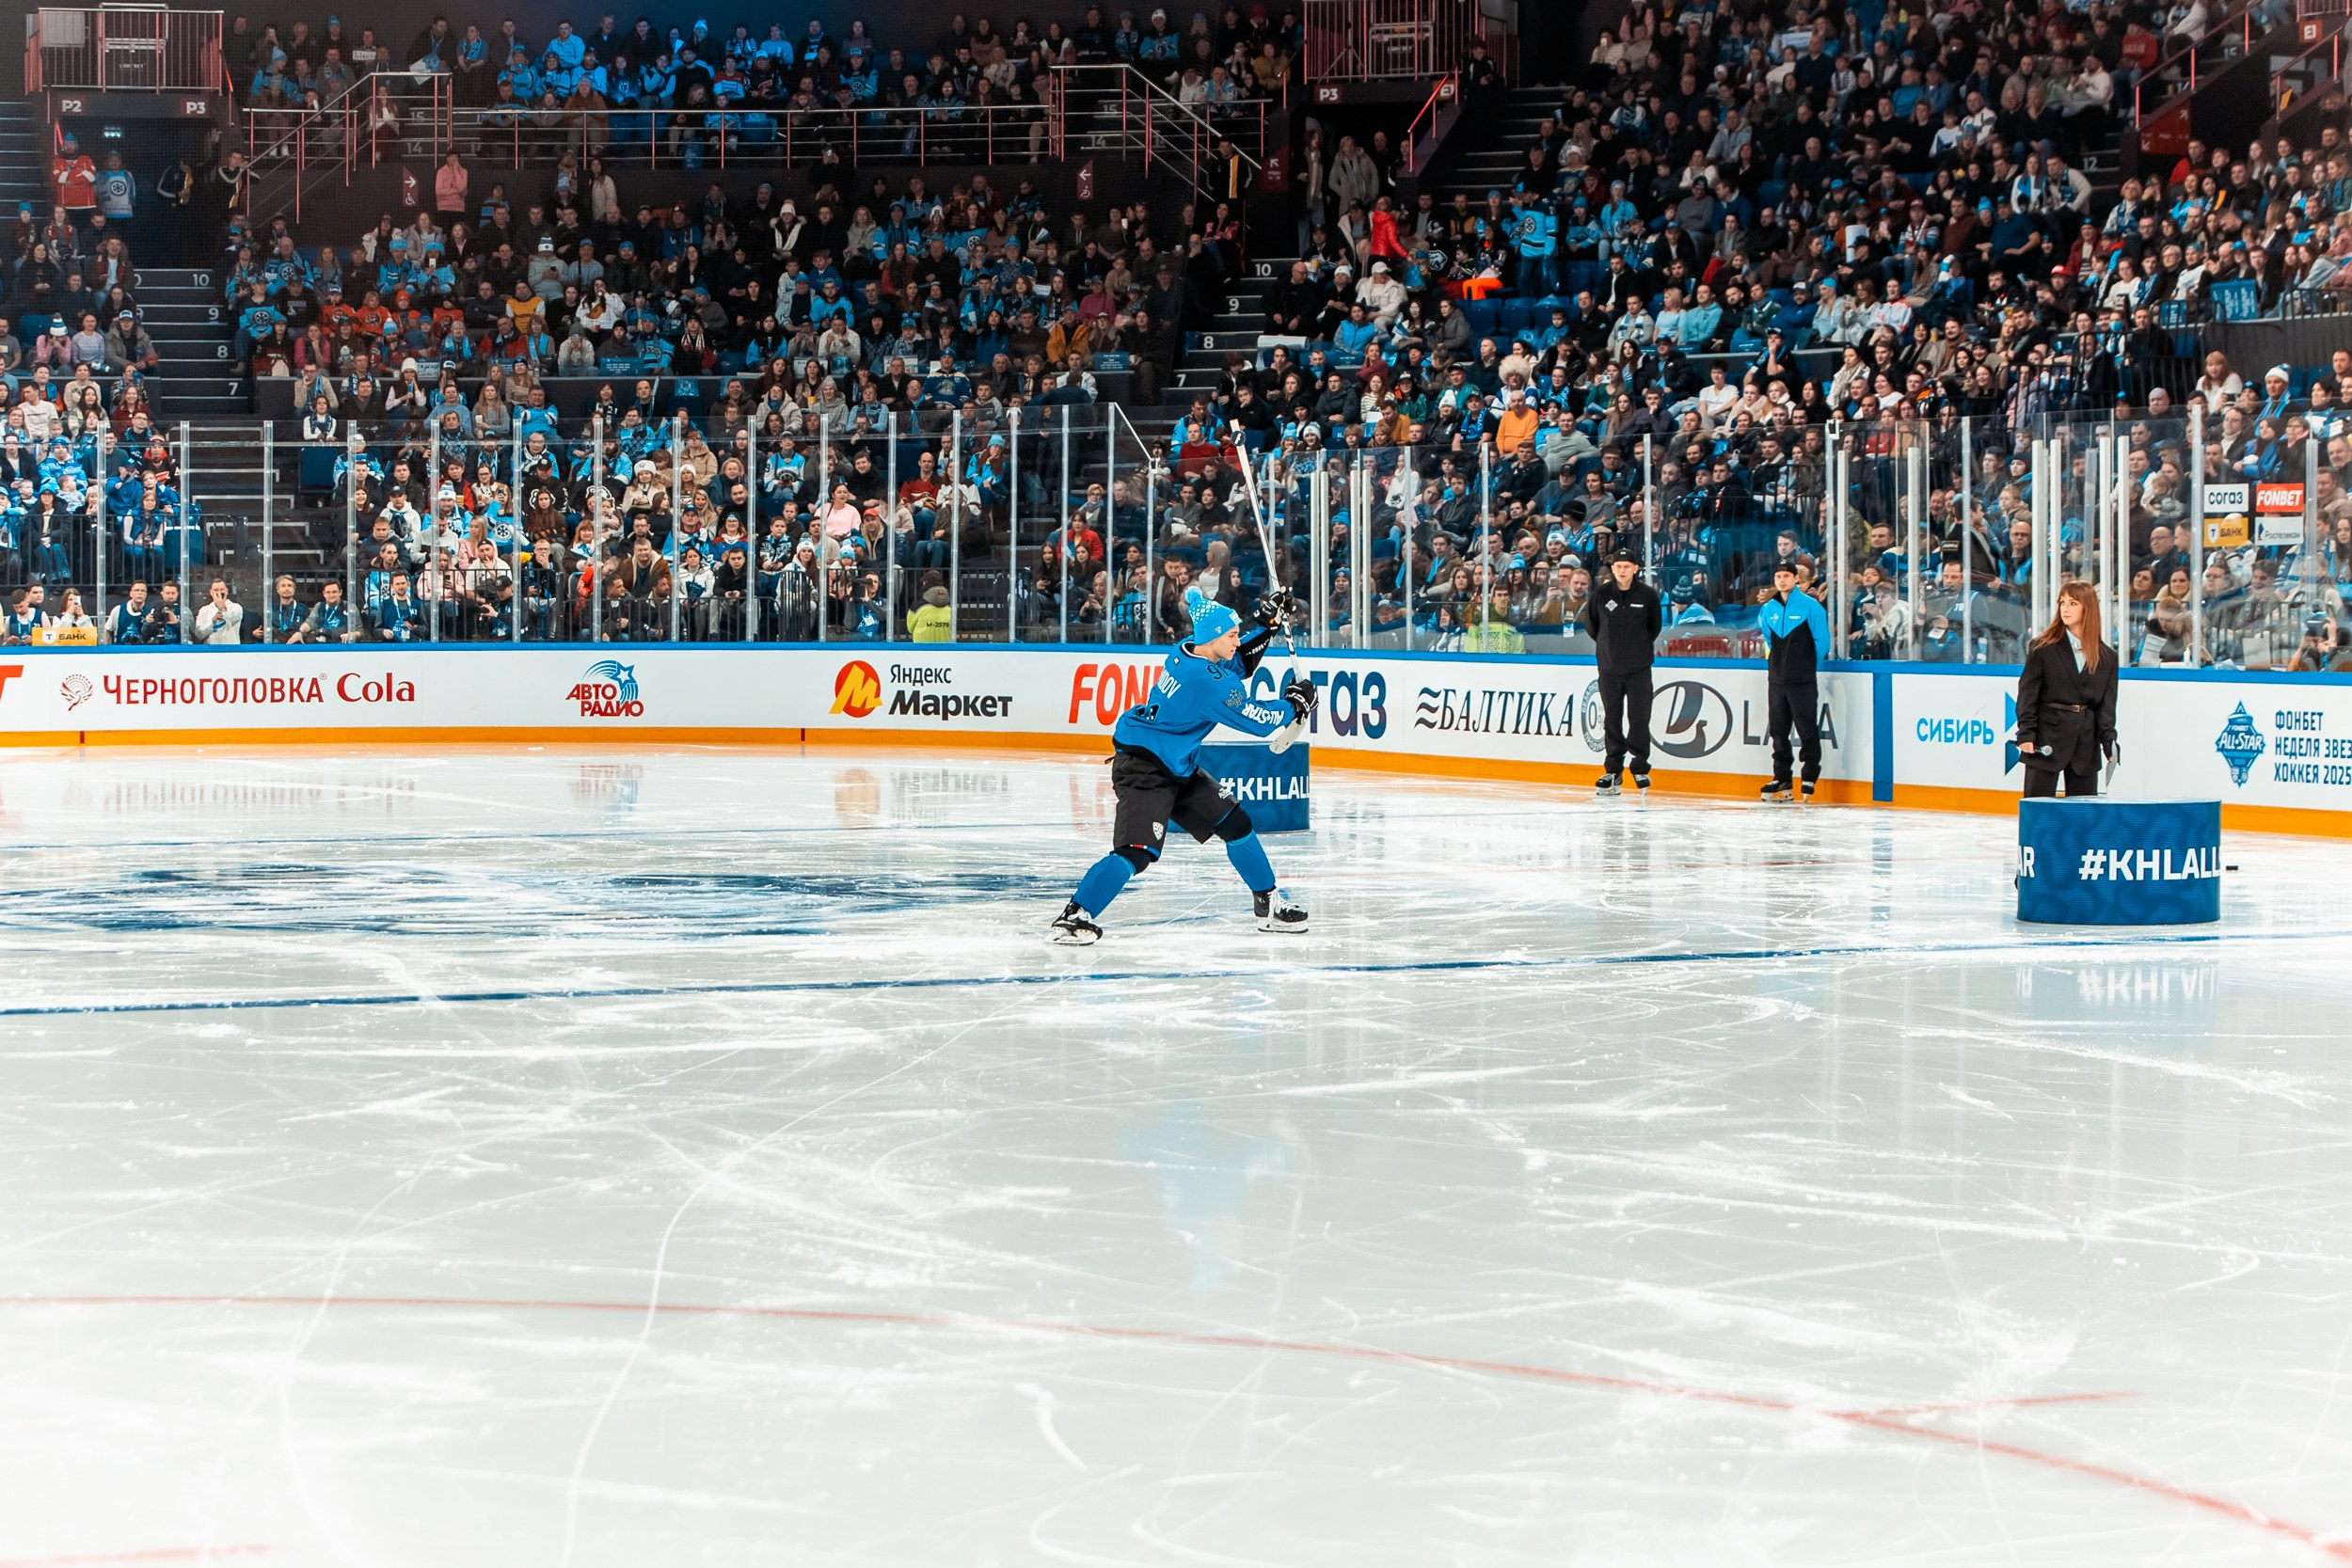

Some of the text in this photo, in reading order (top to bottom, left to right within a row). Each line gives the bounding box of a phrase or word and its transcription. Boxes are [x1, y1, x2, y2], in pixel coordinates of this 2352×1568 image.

[1319, 88, 1339, 101] P3
[62, 100, 82, 113] P2
[186, 102, 206, 114] P3
[410, 111, 424, 122] 15
[408, 142, 422, 154] 14
[2083, 157, 2098, 170] 12
[1255, 263, 1271, 277] 10
[193, 274, 210, 287] 10
[1229, 298, 1239, 311] 9
[209, 308, 219, 320] 9
[1203, 336, 1214, 349] 8
[217, 345, 228, 358] 8
[1176, 373, 1186, 388] 7
[229, 382, 239, 396] 7
[2256, 490, 2303, 507] FONBET
[2220, 527, 2243, 538] БАНК
[890, 664, 952, 687] Яндекс
[337, 672, 416, 704] Cola
[564, 683, 618, 701] АВТО
[1068, 662, 1164, 726] FON
[580, 700, 644, 718] РАДИО
[888, 689, 1013, 721] Маркет
[1438, 688, 1575, 737] БАЛТИКА
[1743, 700, 1839, 750] LA
[2275, 709, 2324, 732] ФОНБЕТ
[1916, 717, 1994, 745] СИБИРЬ
[2274, 736, 2320, 760] НЕДЕЛЯ
[2273, 762, 2352, 786] ХОККЕЯ 2025
